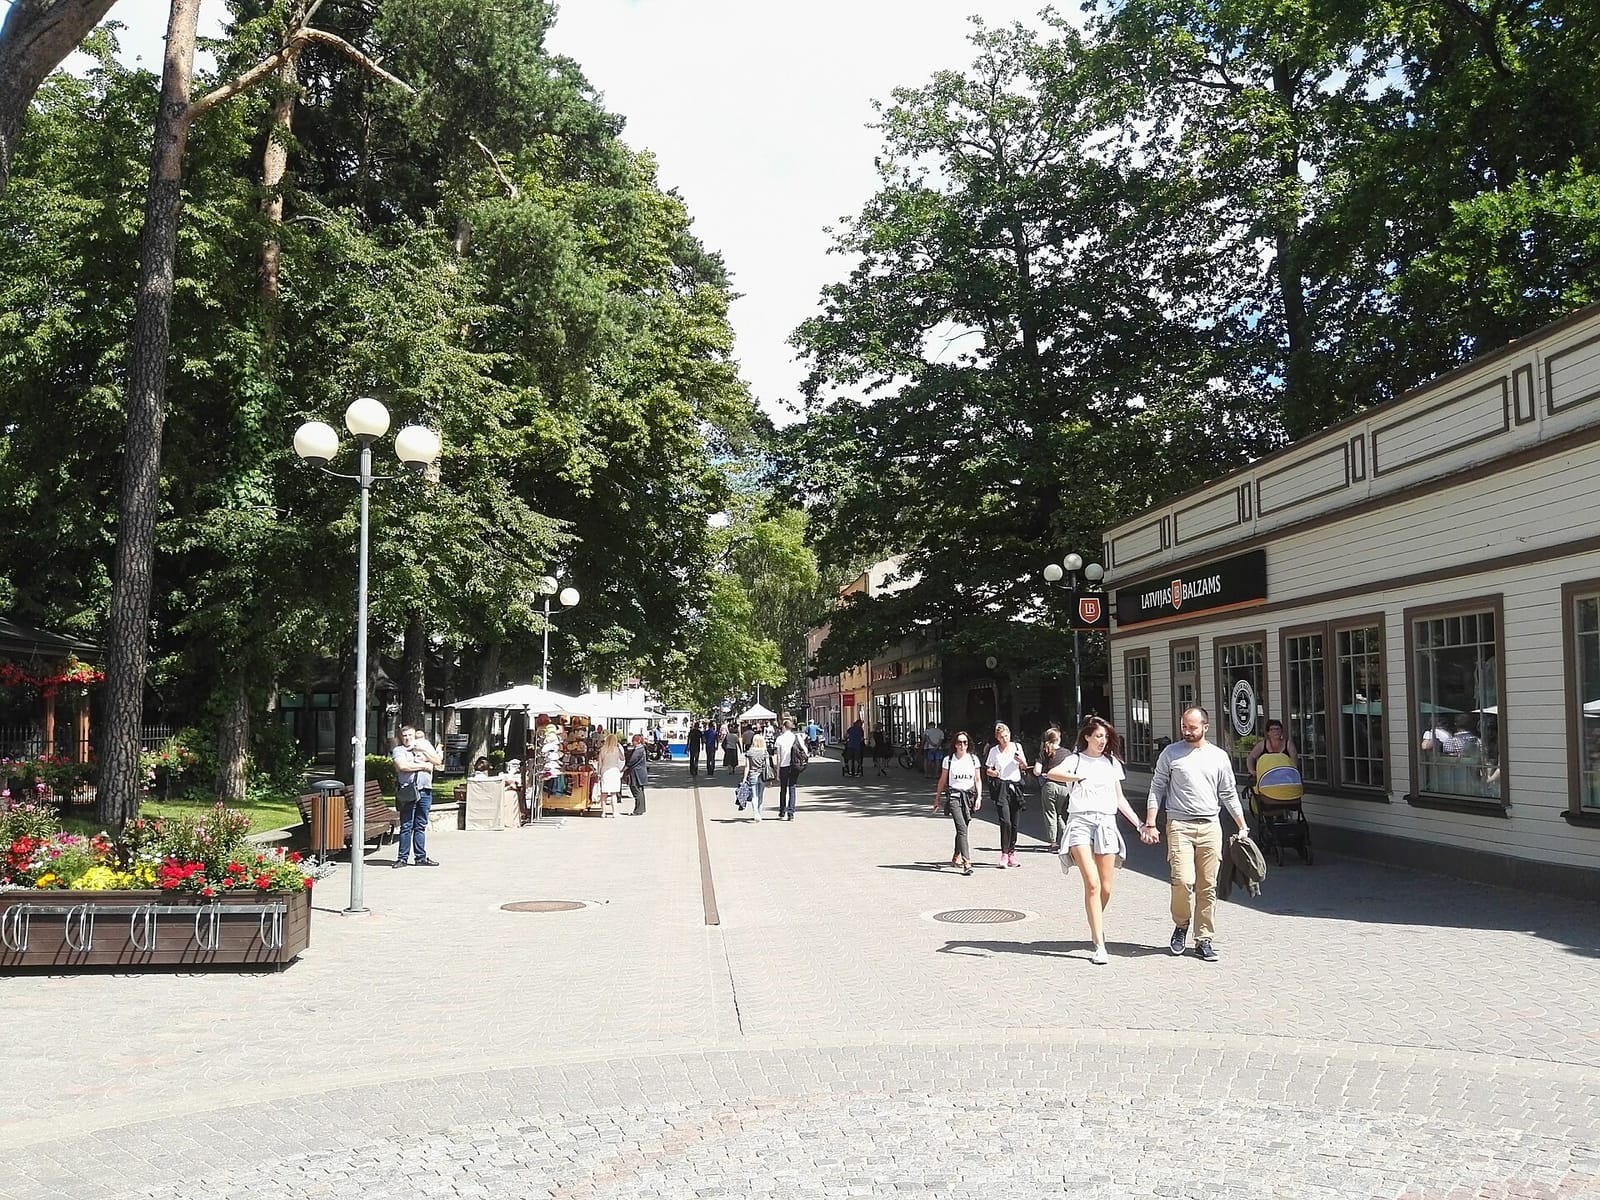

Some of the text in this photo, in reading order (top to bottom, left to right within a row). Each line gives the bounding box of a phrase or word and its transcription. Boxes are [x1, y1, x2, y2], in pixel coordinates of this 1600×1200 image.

[1141, 588, 1171, 609] LATVIJAS
[1182, 575, 1221, 600] BALZAMS
[1085, 603, 1095, 614] LB
